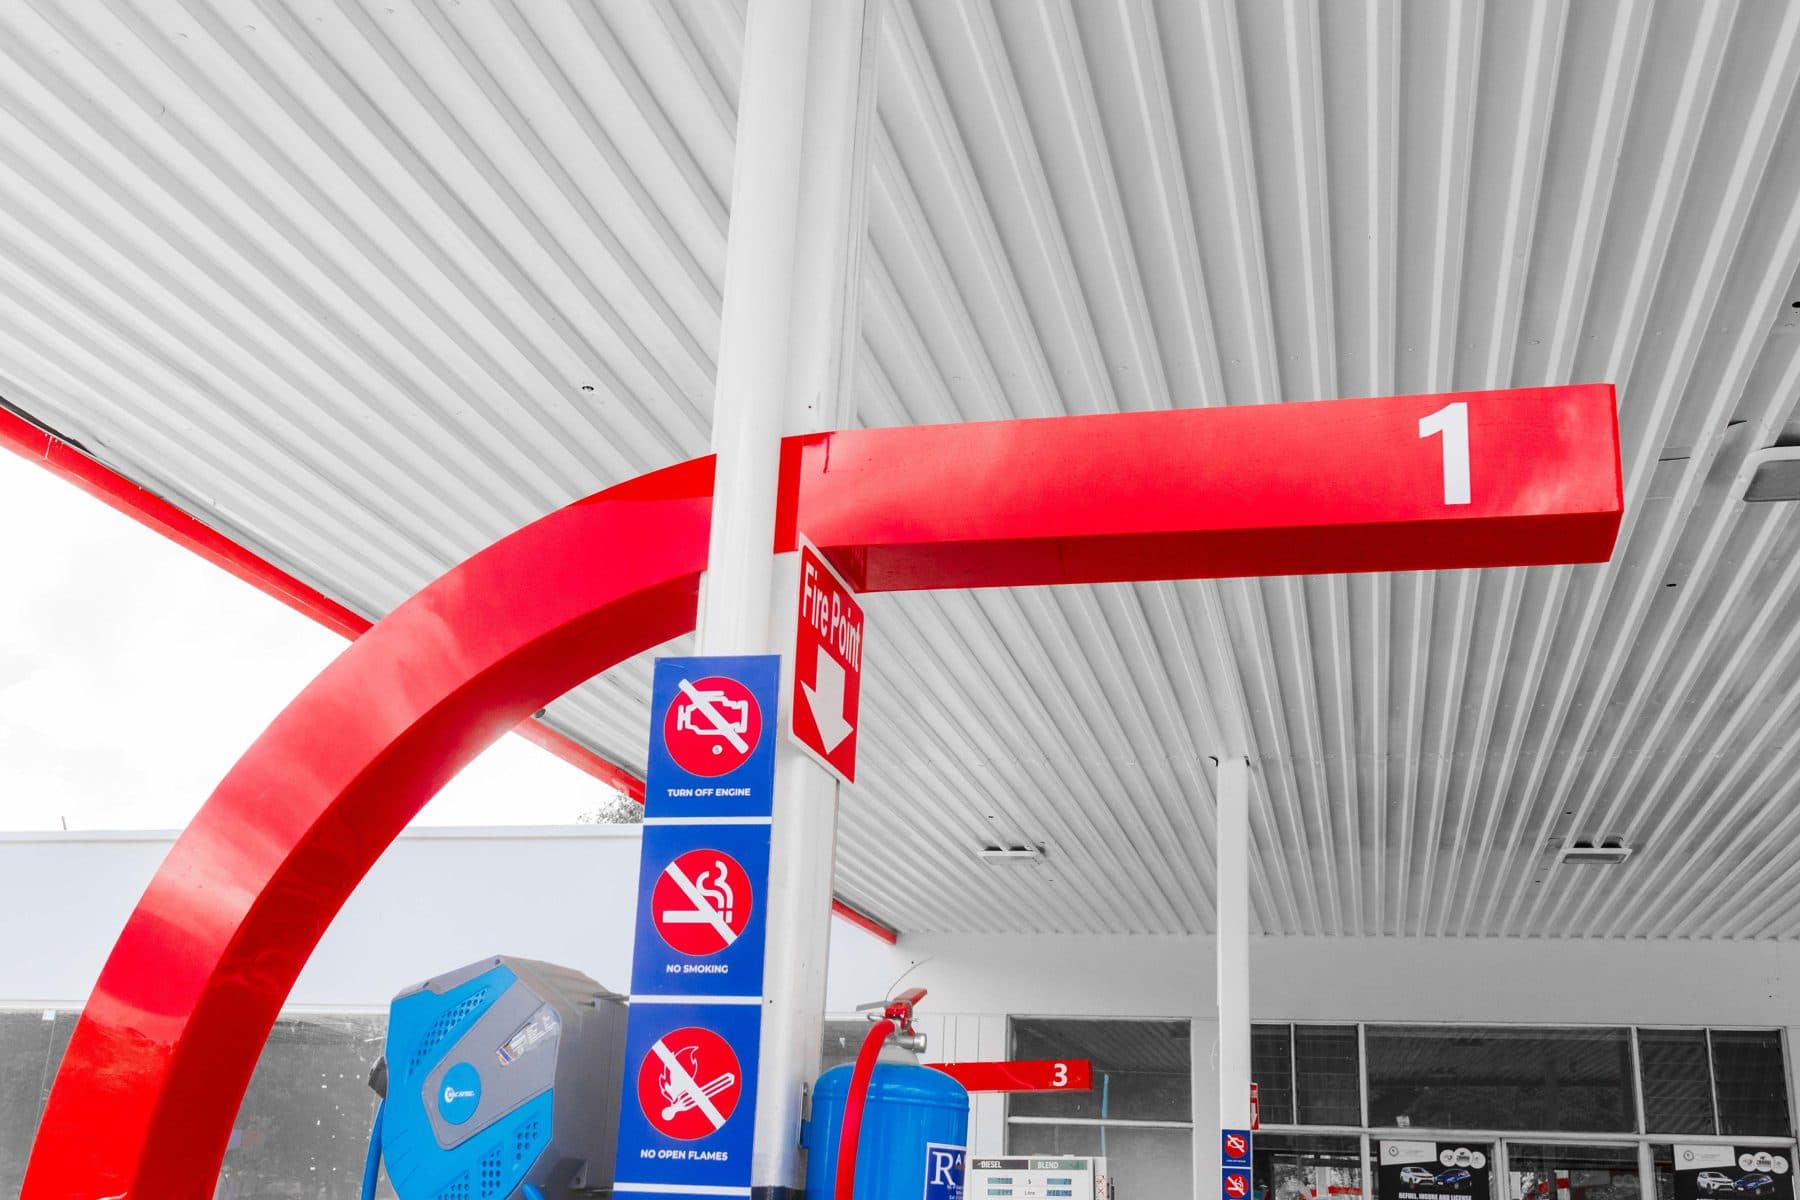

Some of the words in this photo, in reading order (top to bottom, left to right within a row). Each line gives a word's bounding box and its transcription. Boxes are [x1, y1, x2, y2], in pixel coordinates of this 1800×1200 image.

[1418, 402, 1471, 505] 1
[802, 561, 829, 638] Fire
[830, 590, 861, 673] Point
[667, 788, 693, 797] TURN
[694, 788, 714, 797] OFF
[715, 787, 751, 797] ENGINE
[666, 964, 681, 974] NO
[683, 964, 729, 974] SMOKING
[1052, 1063, 1068, 1087] 3
[640, 1149, 656, 1159] NO
[657, 1149, 686, 1160] OPEN
[688, 1150, 728, 1161] FLAMES
[981, 1161, 1002, 1169] DIESEL
[1037, 1161, 1059, 1169] BLEND
